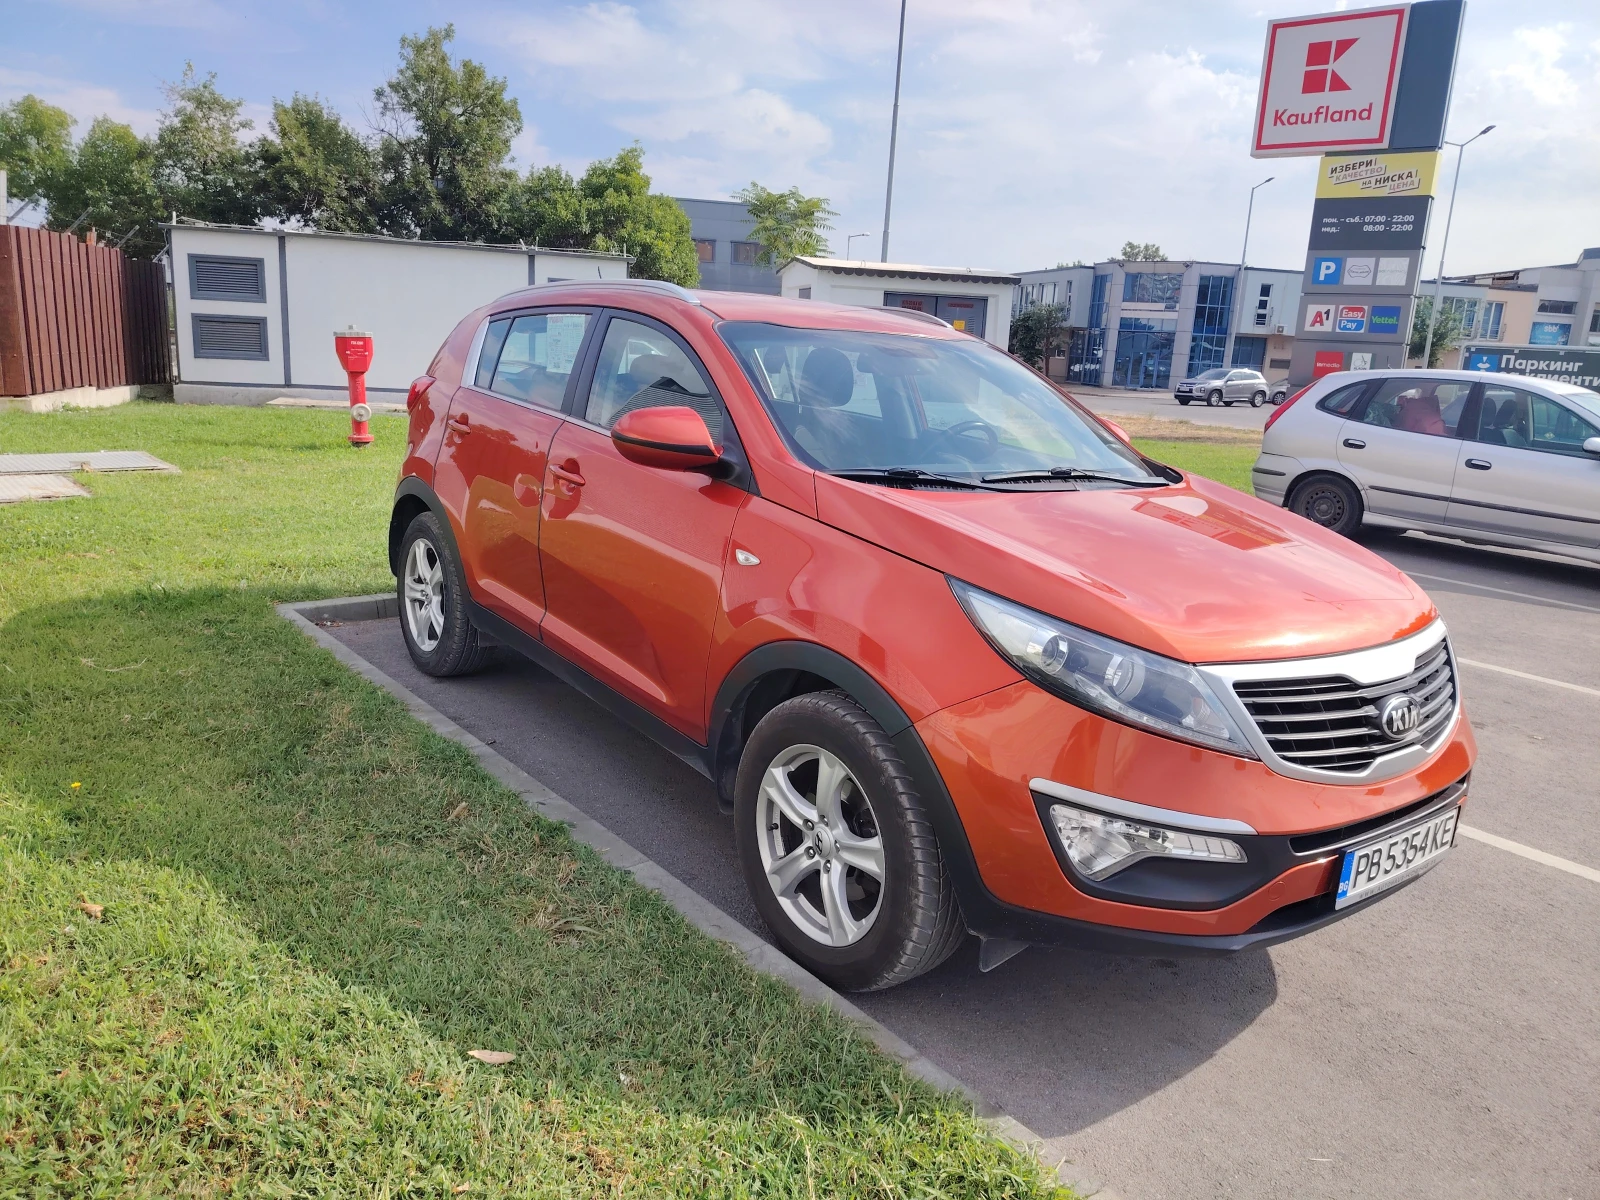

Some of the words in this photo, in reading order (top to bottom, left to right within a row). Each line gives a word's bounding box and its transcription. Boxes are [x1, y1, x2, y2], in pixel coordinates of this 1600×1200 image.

[1273, 102, 1373, 126] Kaufland
[1363, 224, 1385, 232] 08:00
[1391, 224, 1413, 232] 22:00
[1364, 215, 1386, 223] 07:00
[1319, 261, 1336, 281] P
[1309, 308, 1331, 328] A1
[1342, 309, 1363, 319] Easy
[1340, 320, 1357, 330] Pay
[1500, 354, 1584, 372] Паркинг
[1391, 704, 1419, 732] KIA
[1353, 847, 1382, 889] PB
[1383, 829, 1429, 875] 5354
[1428, 815, 1455, 854] KE
[1338, 880, 1349, 894] BG
